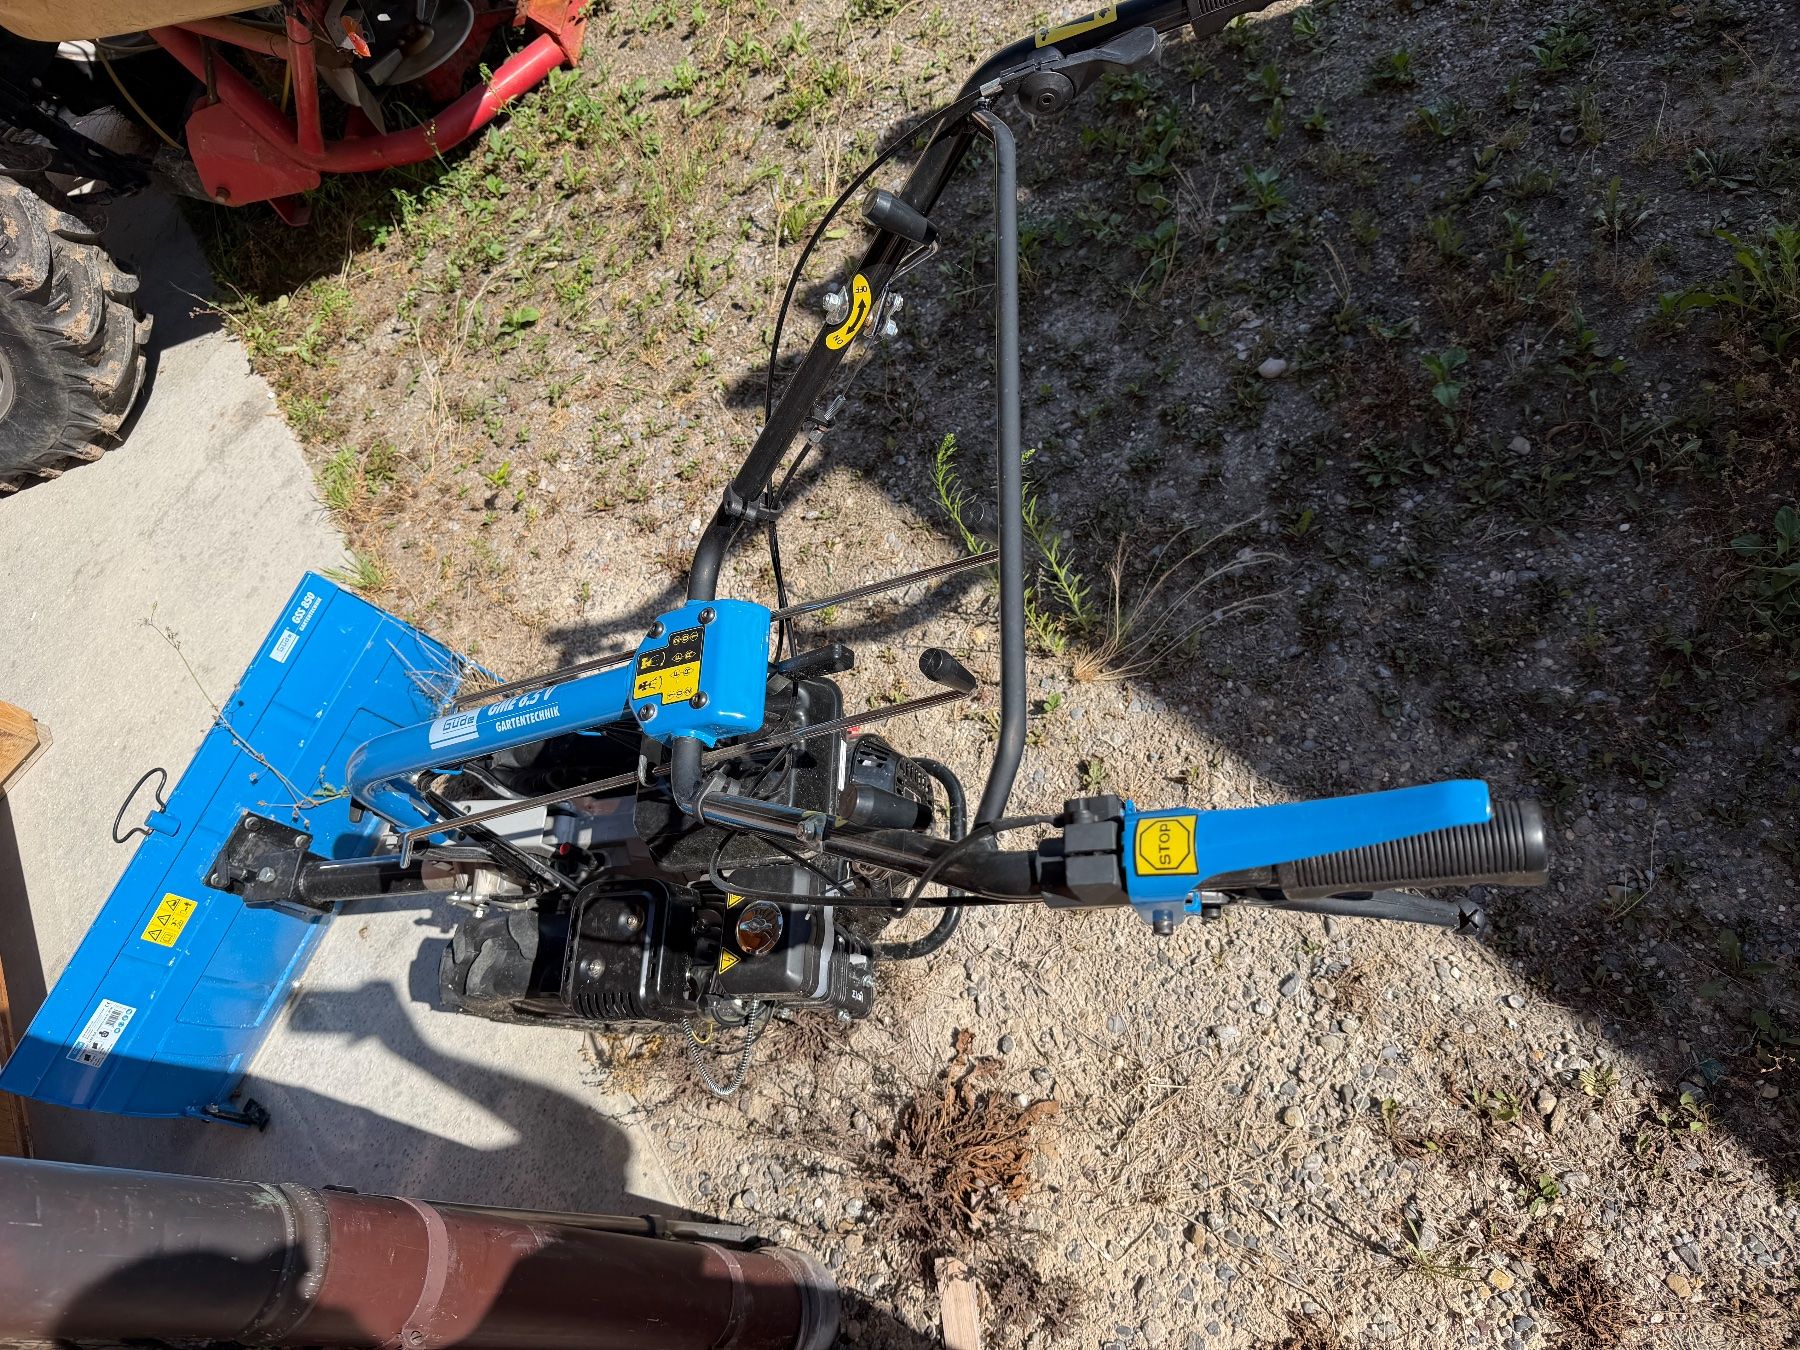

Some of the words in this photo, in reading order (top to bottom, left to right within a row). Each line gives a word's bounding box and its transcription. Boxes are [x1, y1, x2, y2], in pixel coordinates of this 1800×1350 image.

[855, 285, 868, 294] OFF
[832, 334, 844, 345] ON
[291, 606, 306, 625] GSS
[300, 591, 316, 609] 850
[495, 705, 561, 733] GARTENTECHNIK
[1158, 823, 1172, 865] STOP
